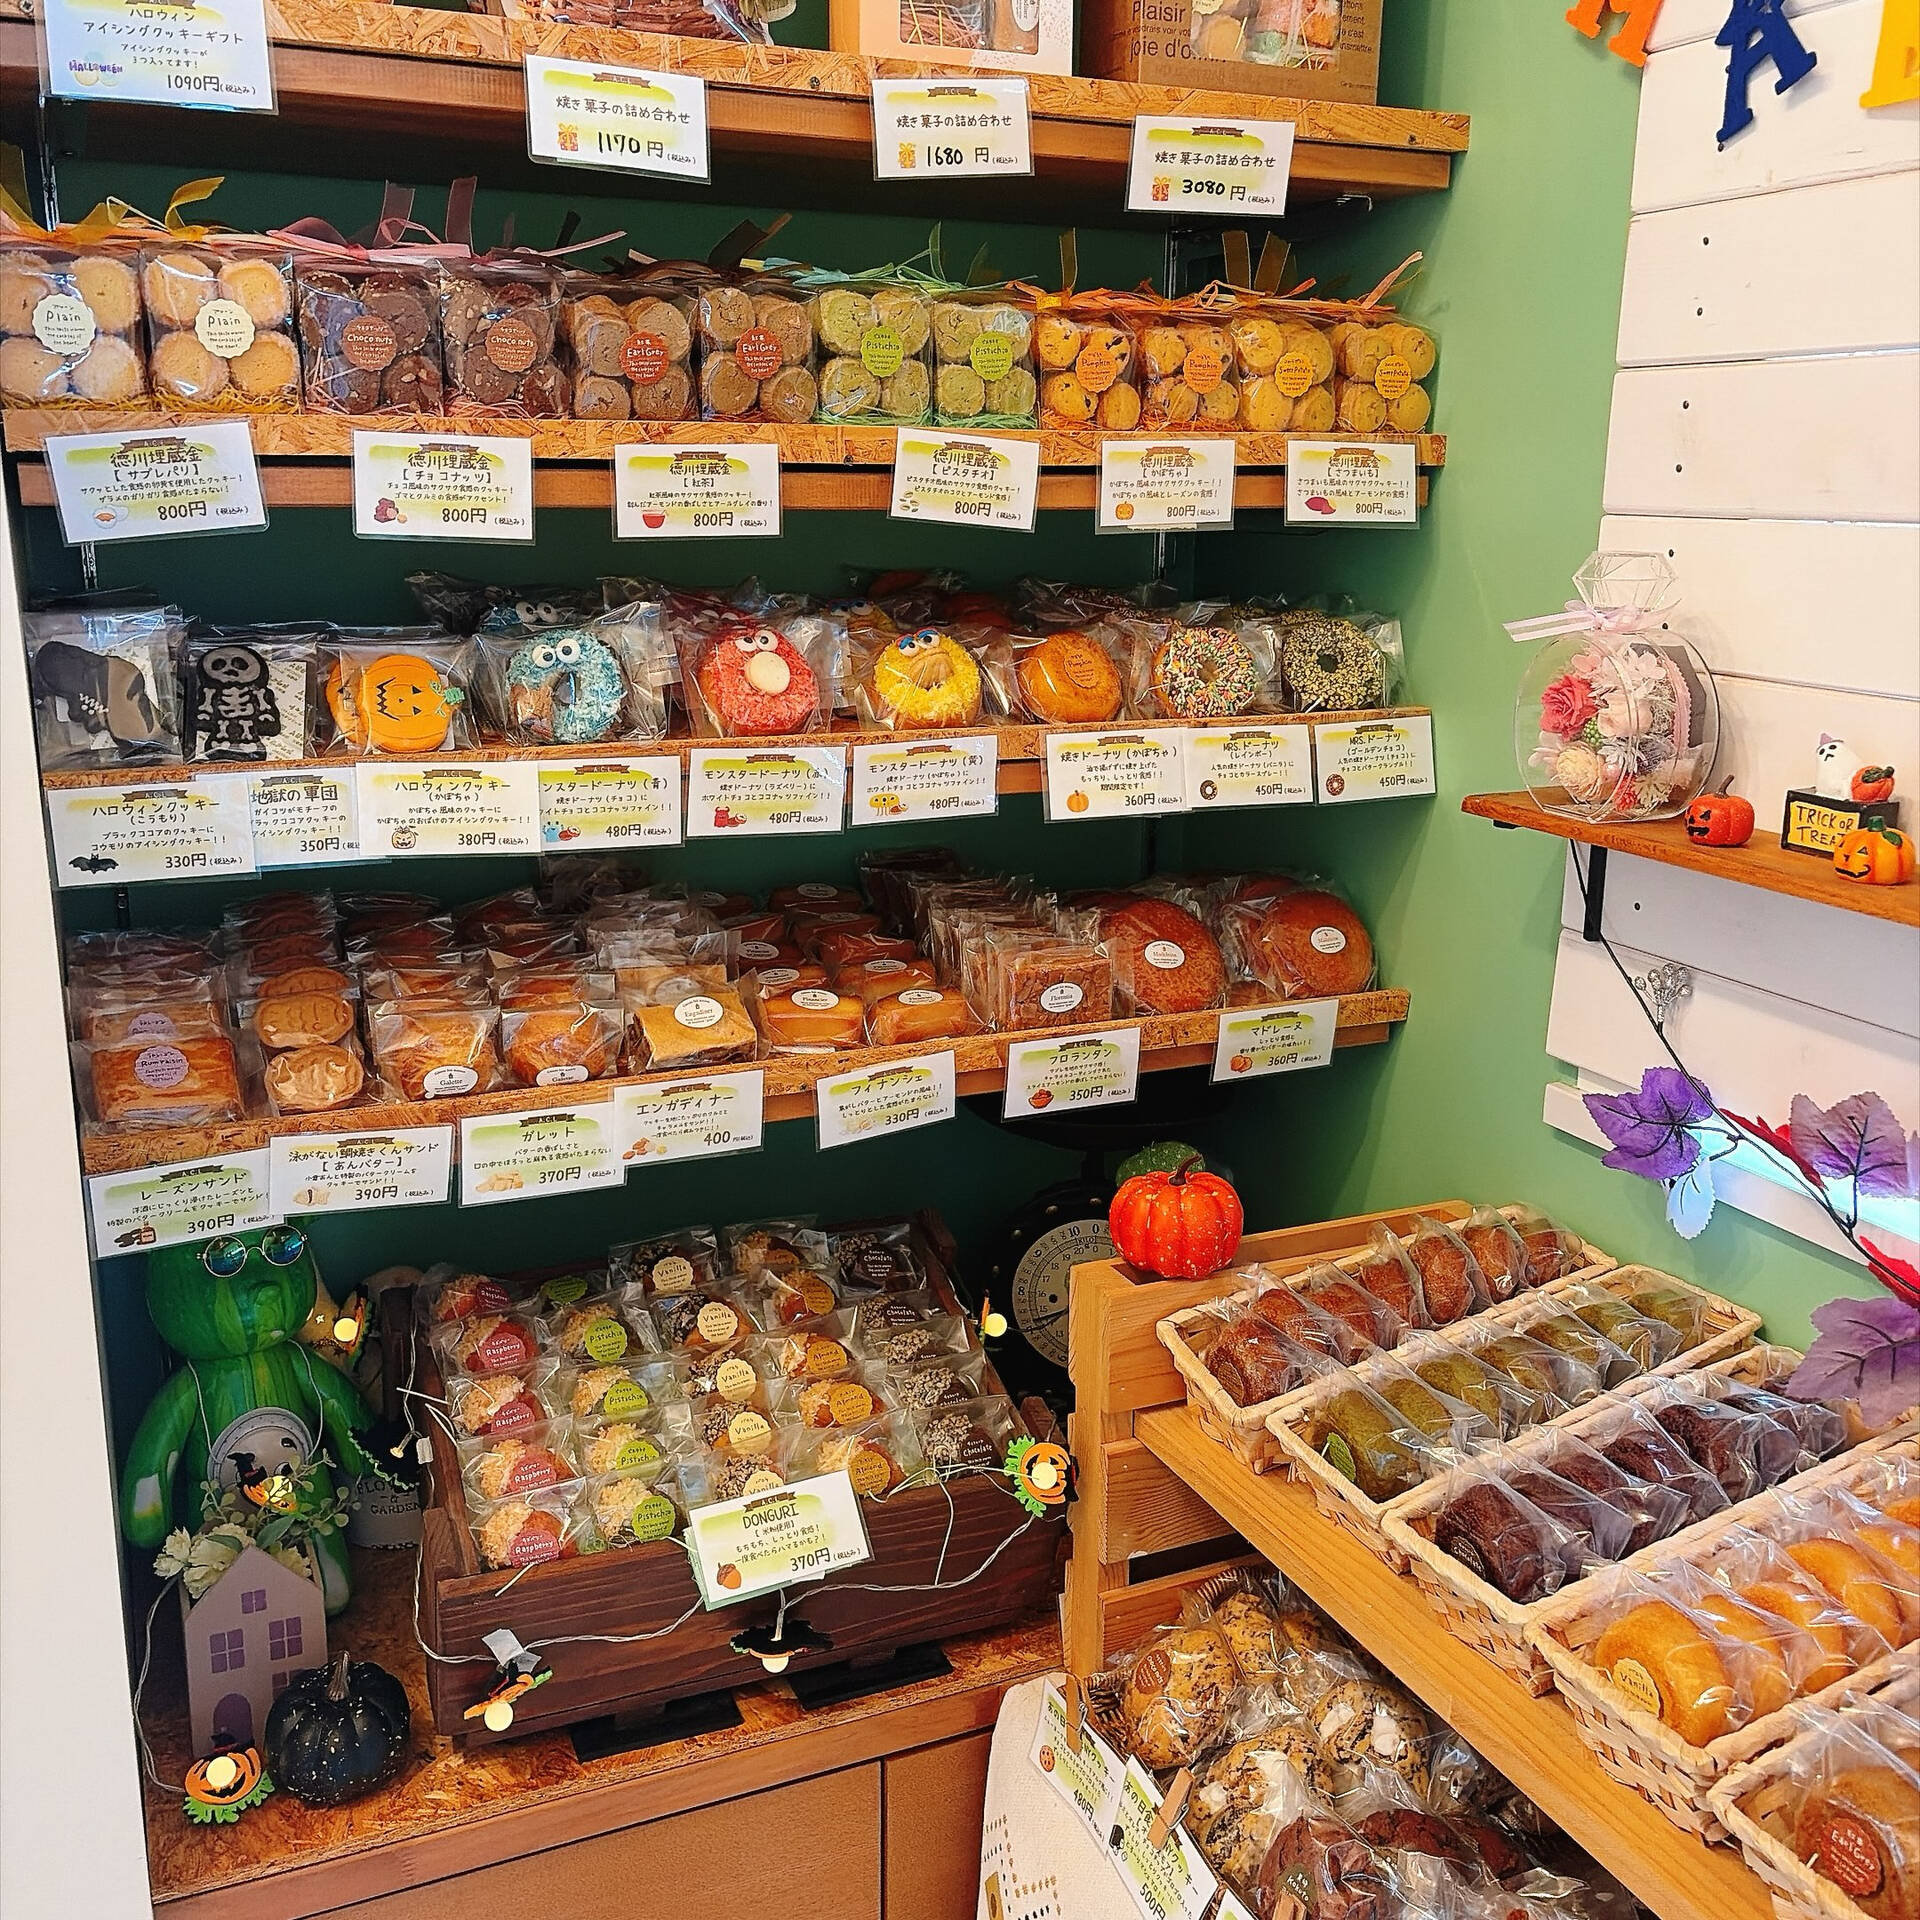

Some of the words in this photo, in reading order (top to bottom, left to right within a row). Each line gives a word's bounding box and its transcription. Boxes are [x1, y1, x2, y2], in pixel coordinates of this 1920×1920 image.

[129, 8, 196, 22] ハロウィン
[1131, 1, 1186, 22] Plaisir
[83, 21, 244, 44] アイシングクッキーギフト
[1129, 37, 1159, 63] joie
[556, 95, 690, 124] 焼き菓子の詰め合わせ
[896, 113, 1012, 128] 焼き菓子の詰め合わせ
[1155, 150, 1276, 168] 焼き菓子の詰め合わせ
[46, 310, 81, 322] Plain
[208, 316, 241, 328] Plain
[110, 446, 204, 468] 徳川埋蔵金
[408, 453, 493, 471] 徳川埋蔵金
[933, 449, 1001, 470] 徳川埋蔵金
[1140, 455, 1196, 469] 徳川埋蔵金
[113, 463, 201, 483] 【サブレパリ】
[402, 469, 492, 484] 【チョコナッツ】
[669, 462, 733, 476] 徳川埋蔵金
[931, 464, 996, 481] 【ピスタチオ】
[1142, 468, 1189, 478] 【かぼちゃ】
[1327, 469, 1380, 478] 【さつまいも】
[682, 477, 716, 488] 【紅茶】
[1060, 746, 1177, 763] 焼きドーナツ（かぼちゃ）
[395, 780, 511, 792] ハロウィンクッキー
[250, 784, 338, 804] 地獄の軍団
[429, 792, 479, 802] （かぼちゃ）
[92, 799, 220, 817] ハロウィンクッキー
[254, 804, 337, 816] ガイコツがモチーフの
[130, 813, 186, 826] （こうもり）
[1796, 805, 1836, 829] TRICK
[102, 826, 214, 839] ブラックココアのクッキーに
[91, 836, 227, 851] コウモリのアイシングクッキー！！
[1251, 1021, 1303, 1037] マドレーヌ
[1049, 1048, 1112, 1065] フロランタン
[851, 1074, 923, 1096] フィナンシェ
[636, 1094, 734, 1116] エンガディナー
[522, 1126, 575, 1143] ガレット
[321, 1157, 403, 1172] 【あんバター】
[140, 1172, 247, 1201] レーズンサンド
[1069, 1225, 1080, 1238] 10
[657, 1264, 688, 1277] Vanilla
[702, 1311, 732, 1323] Vanilla
[589, 1329, 624, 1344] Pistachio
[486, 1342, 521, 1356] Raspberry
[722, 1369, 750, 1383] Vanilla
[609, 1393, 643, 1403] Pistachio
[495, 1411, 531, 1427] Raspberry
[734, 1422, 764, 1435] Vanilla
[514, 1466, 551, 1484] Raspberry
[637, 1509, 672, 1522] Pistachio
[742, 1503, 800, 1529] DONGURI
[515, 1540, 554, 1555] Raspberry
[1620, 1671, 1654, 1698] Vanilla
